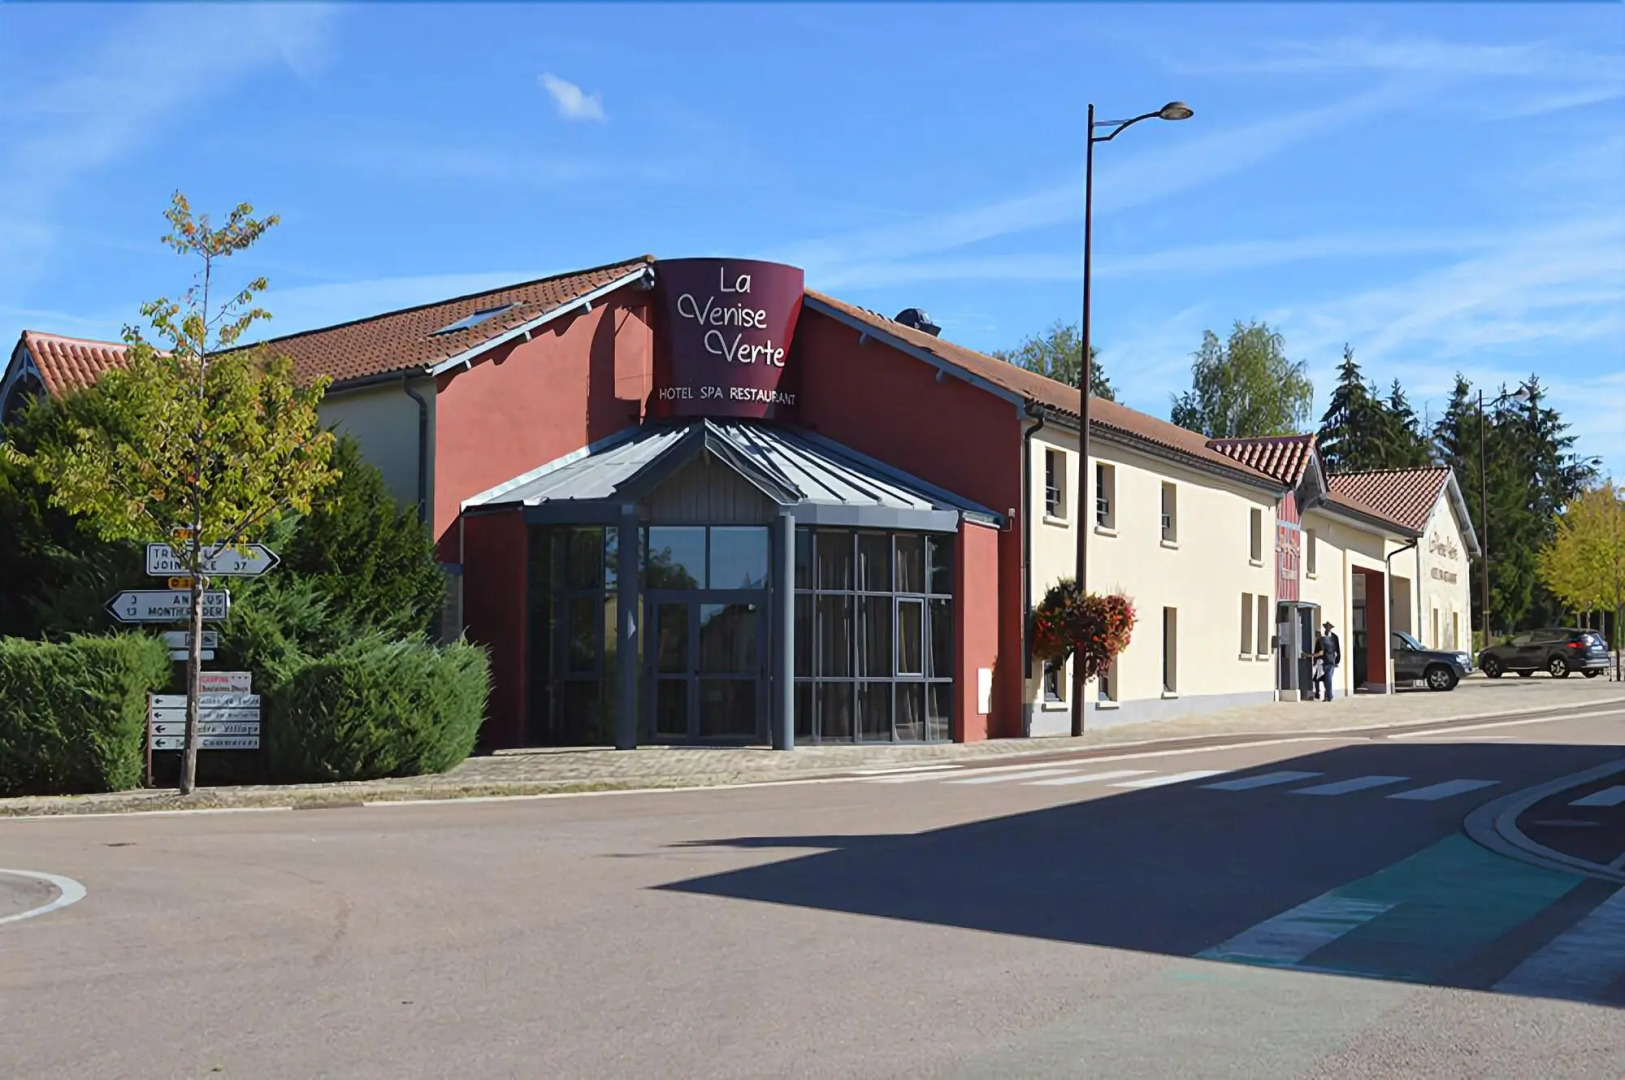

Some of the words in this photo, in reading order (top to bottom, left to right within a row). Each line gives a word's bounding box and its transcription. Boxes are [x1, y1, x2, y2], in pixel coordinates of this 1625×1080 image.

[720, 266, 751, 293] La
[677, 293, 767, 329] Venise
[704, 329, 785, 367] Verte
[659, 387, 694, 400] HOTEL
[700, 386, 724, 399] SPA
[730, 387, 796, 405] RESTAURANT
